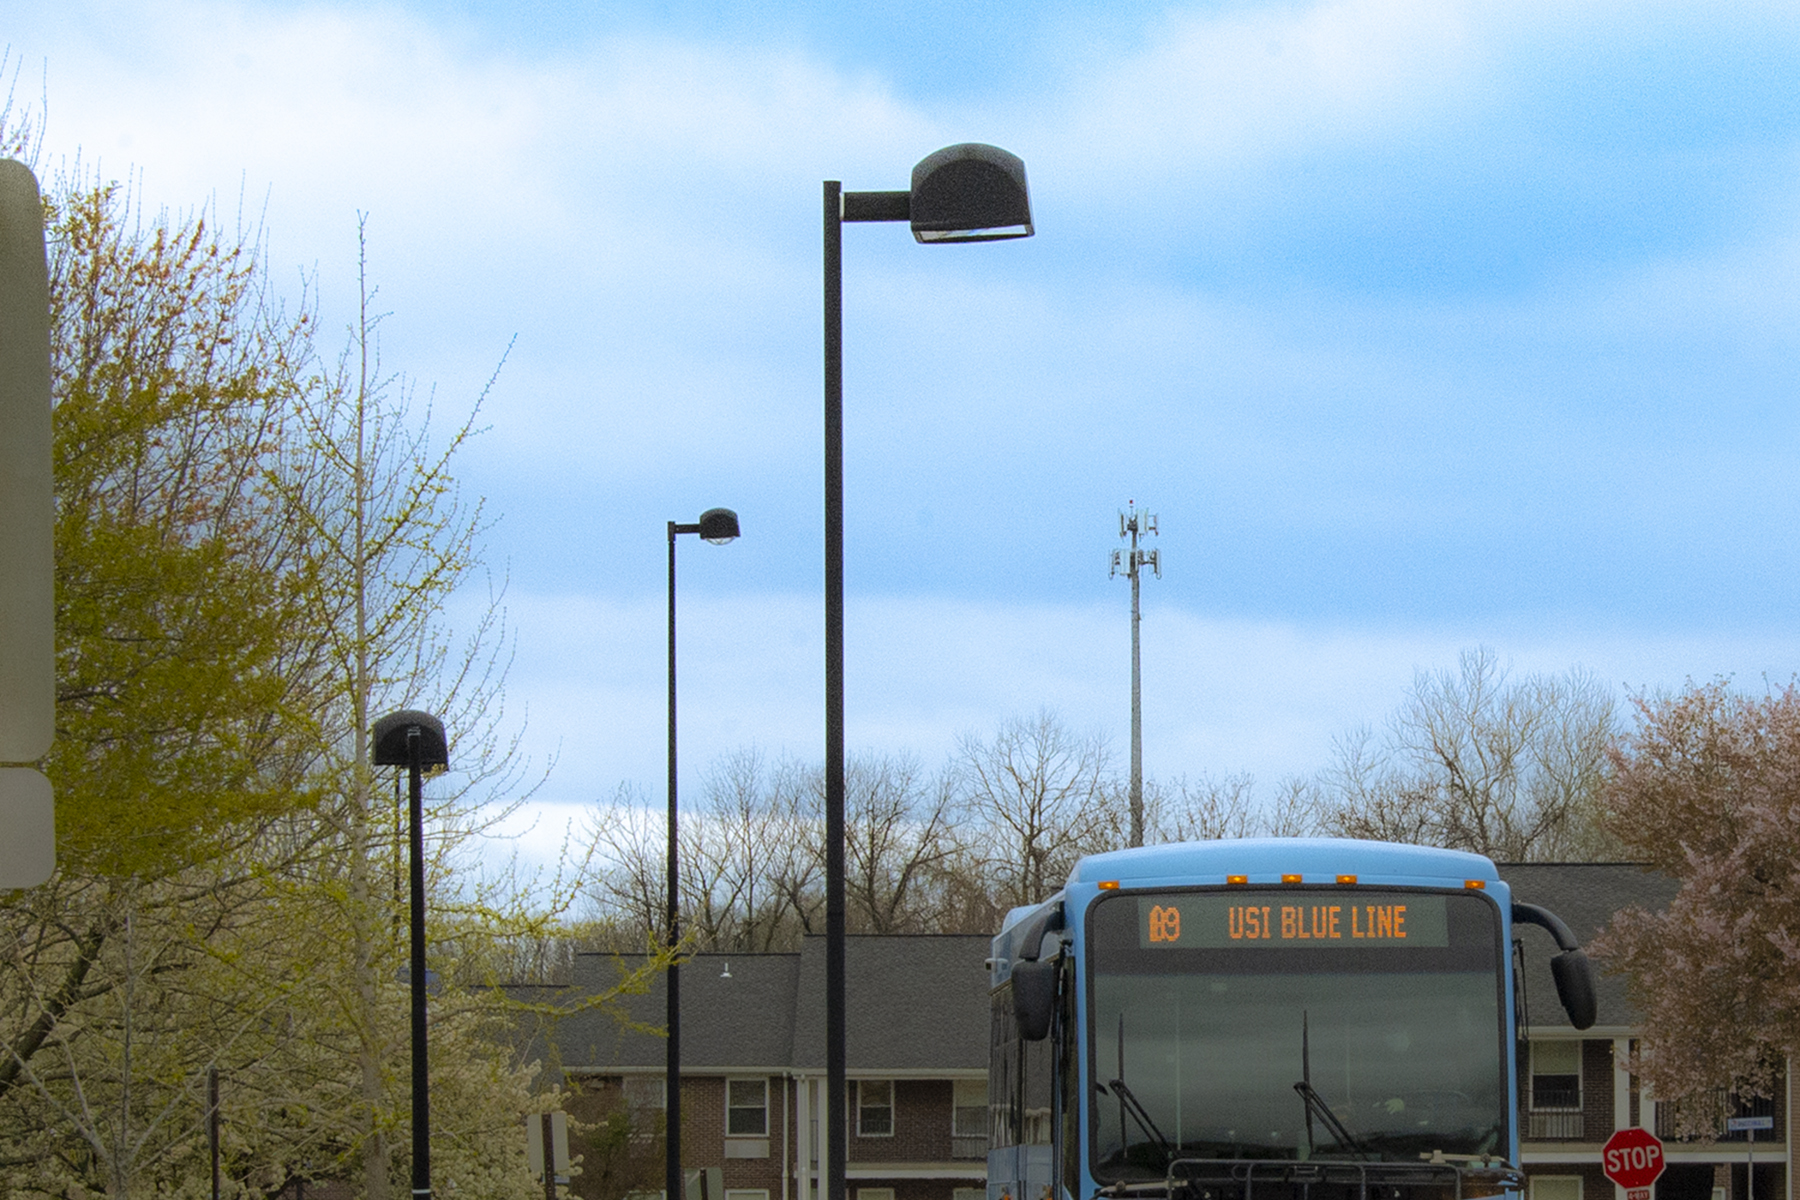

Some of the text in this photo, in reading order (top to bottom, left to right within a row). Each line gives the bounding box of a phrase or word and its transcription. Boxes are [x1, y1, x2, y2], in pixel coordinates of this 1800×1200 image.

[1228, 906, 1271, 939] USI
[1280, 906, 1341, 939] BLUE
[1351, 905, 1407, 938] LINE
[1607, 1145, 1660, 1173] STOP
